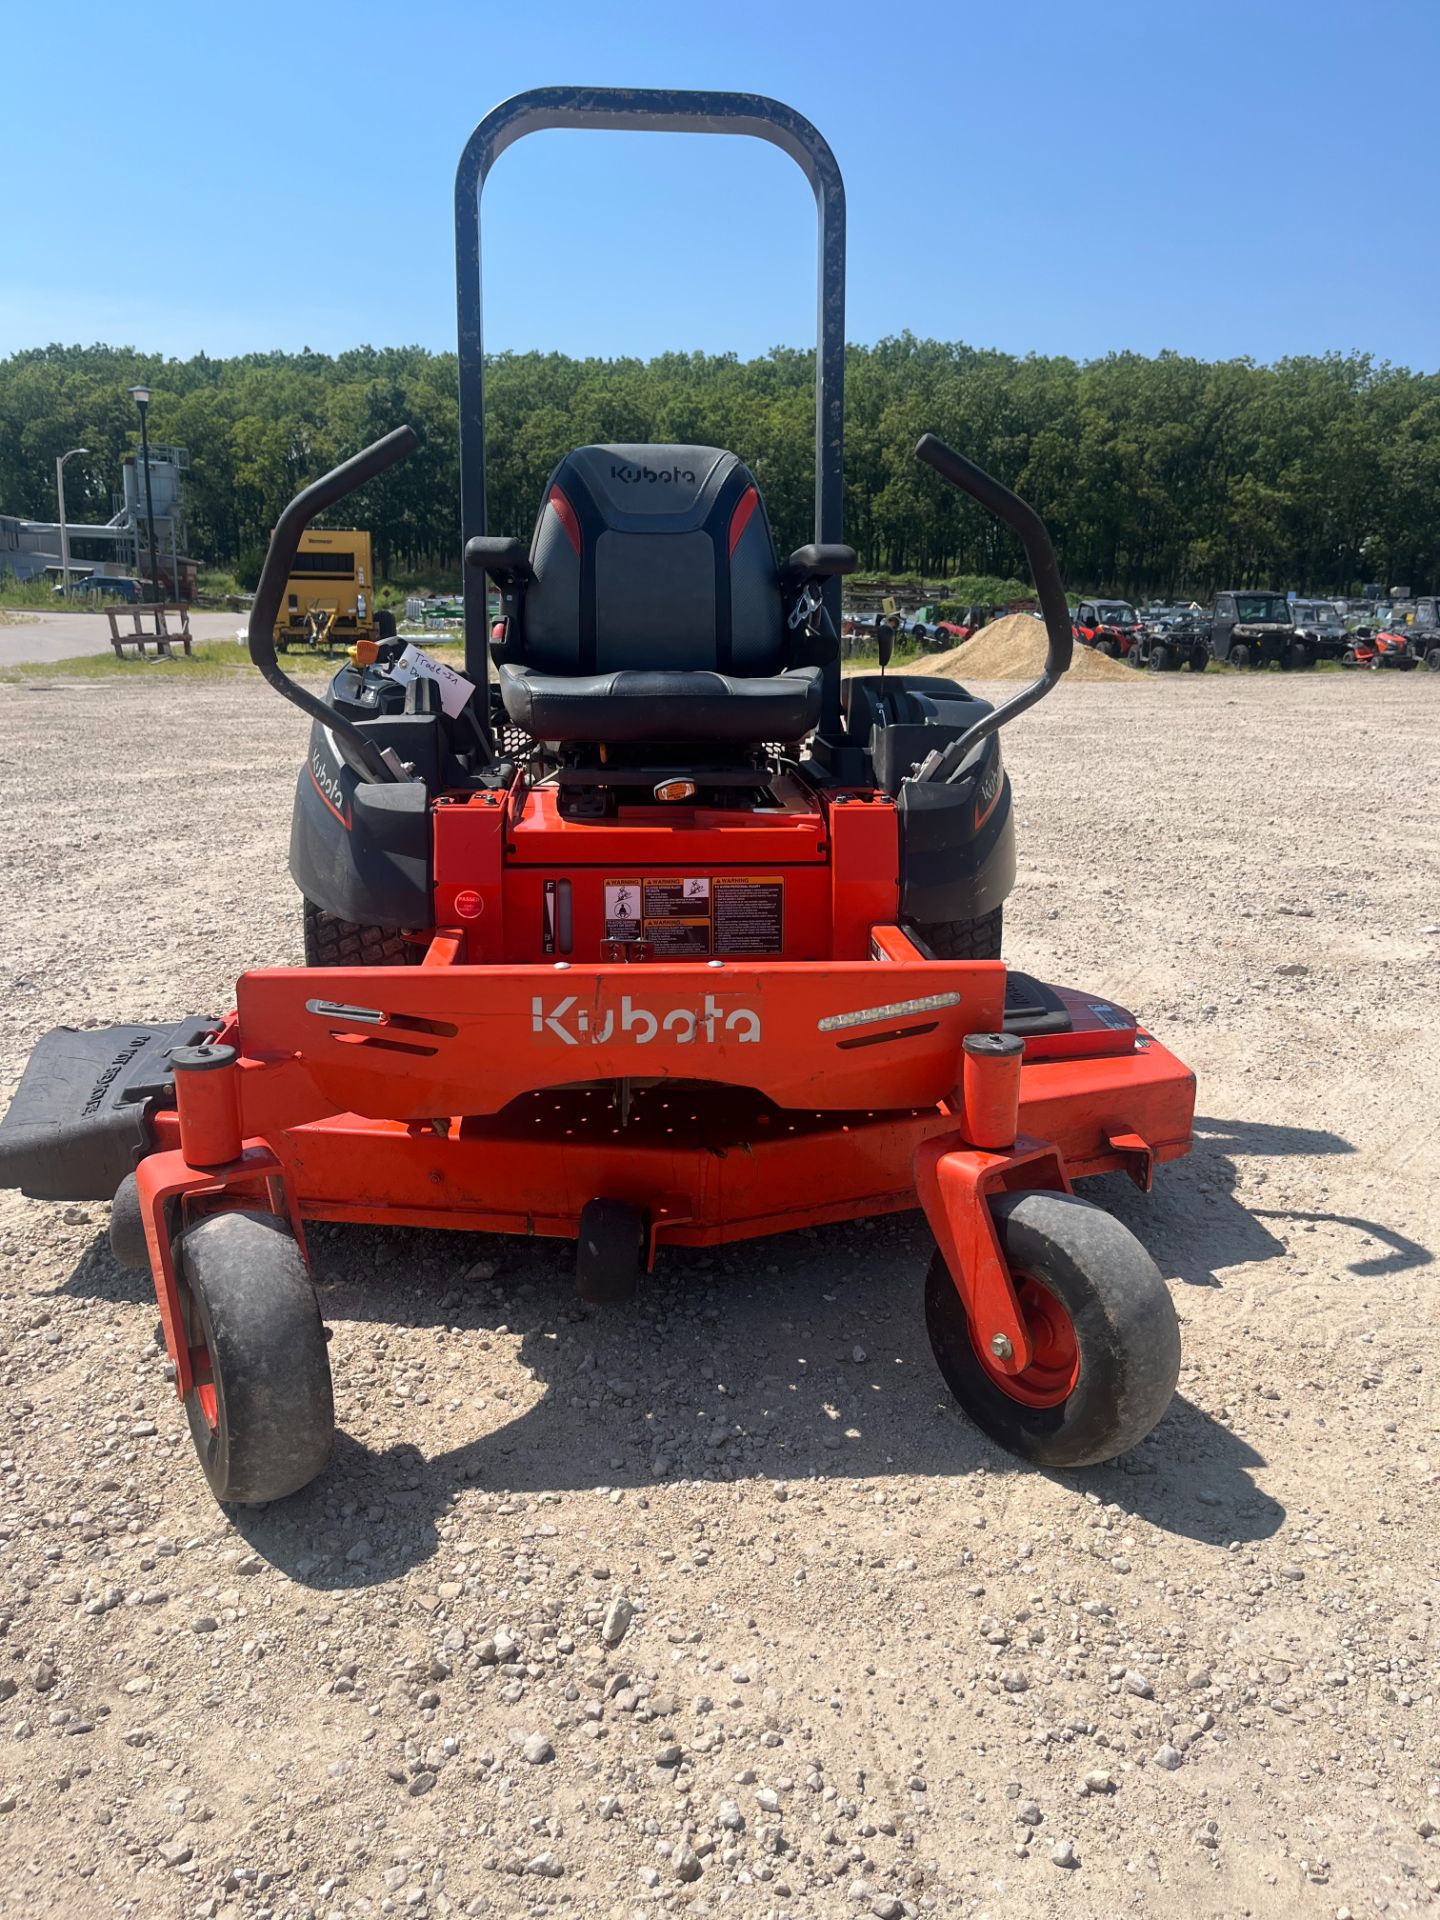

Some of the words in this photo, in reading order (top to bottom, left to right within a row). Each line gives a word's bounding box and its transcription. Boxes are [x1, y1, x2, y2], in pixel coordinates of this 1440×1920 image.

[611, 466, 696, 484] Kubota
[312, 748, 344, 810] Kubota
[547, 882, 554, 890] F
[546, 944, 553, 952] E
[531, 994, 761, 1045] Kubota
